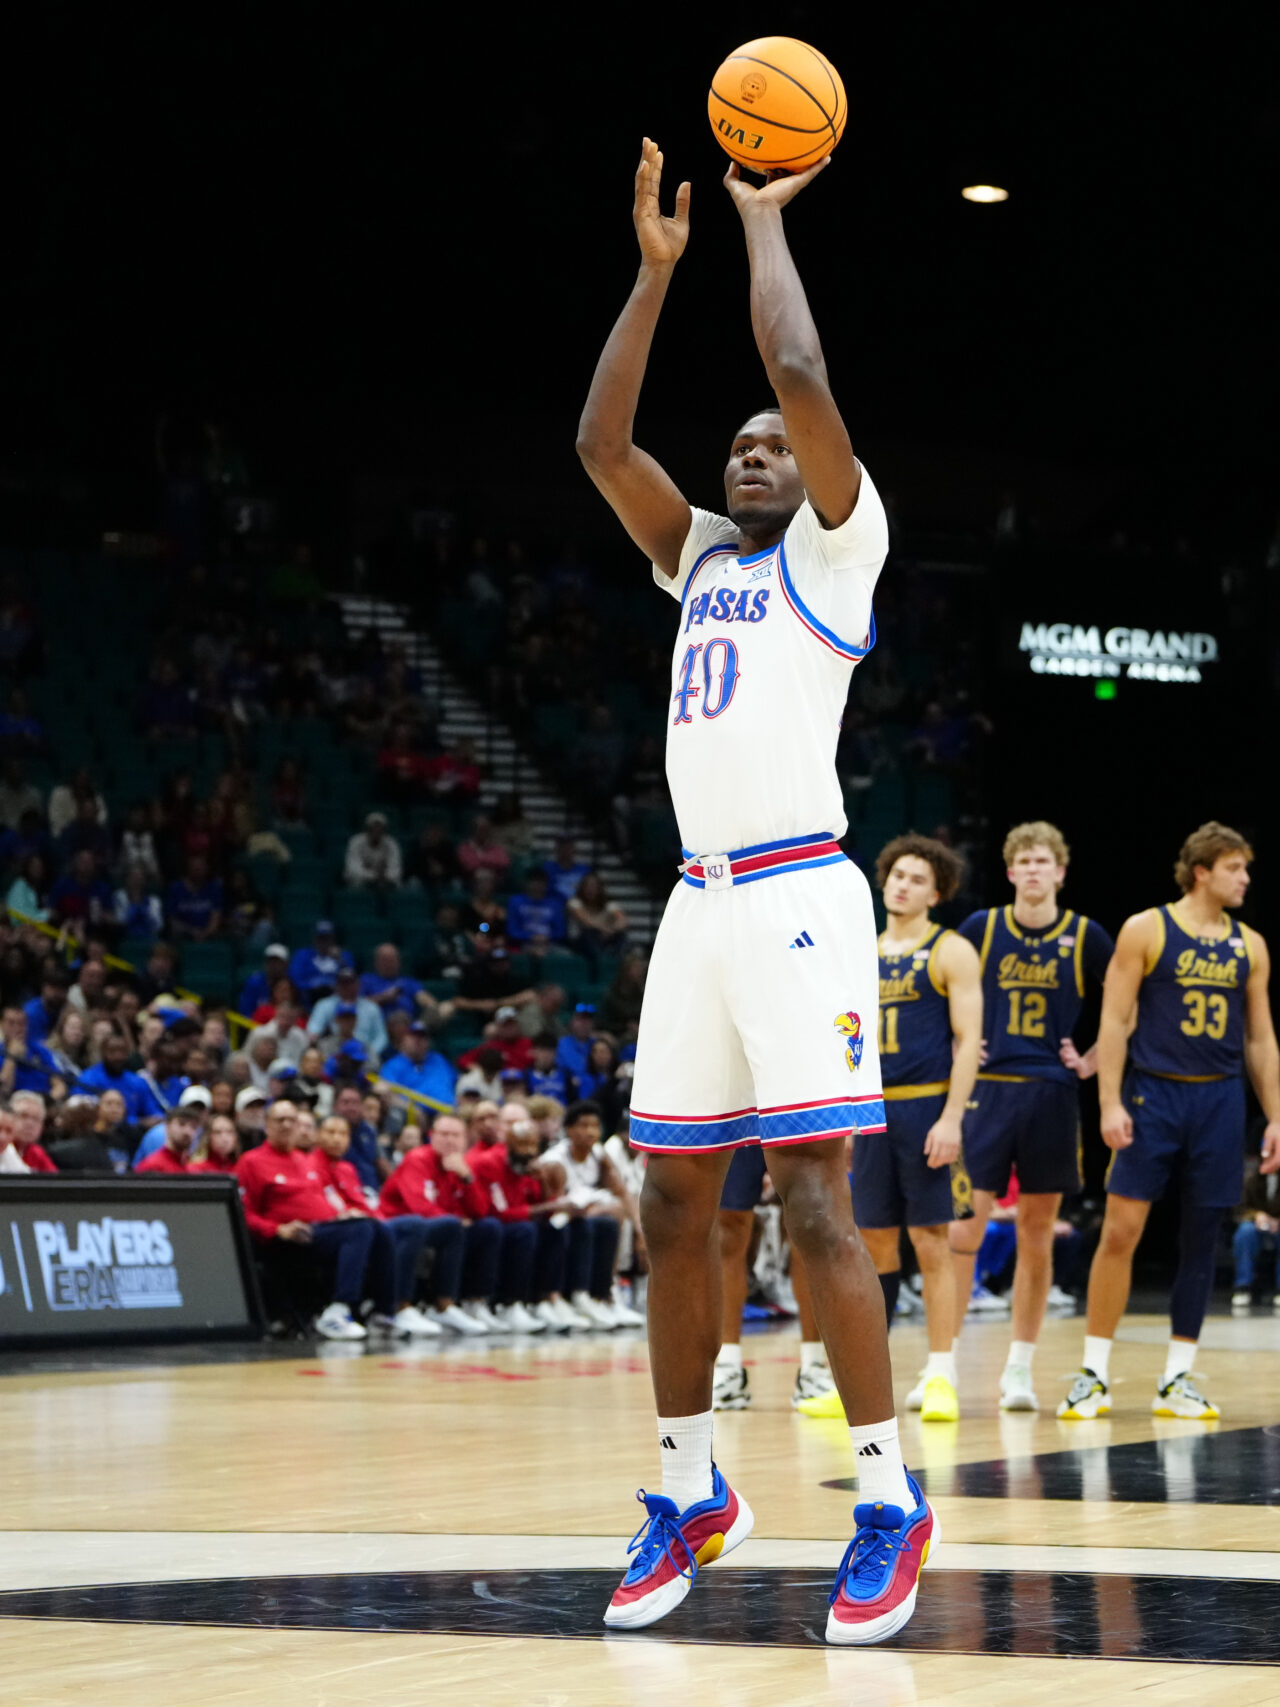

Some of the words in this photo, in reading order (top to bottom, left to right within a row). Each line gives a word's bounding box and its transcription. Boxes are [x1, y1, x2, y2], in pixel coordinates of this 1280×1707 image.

[718, 117, 764, 150] EVO
[1019, 622, 1101, 655] MGM
[1104, 626, 1219, 662] GRAND
[673, 637, 741, 726] 40
[706, 864, 724, 880] KU
[878, 968, 920, 1002] rish
[997, 952, 1059, 989] Irish
[1175, 949, 1238, 988] Irish
[1007, 990, 1047, 1038] 12
[1180, 989, 1229, 1040] 33
[33, 1217, 175, 1266] PLAYERS
[52, 1263, 122, 1311] ERA
